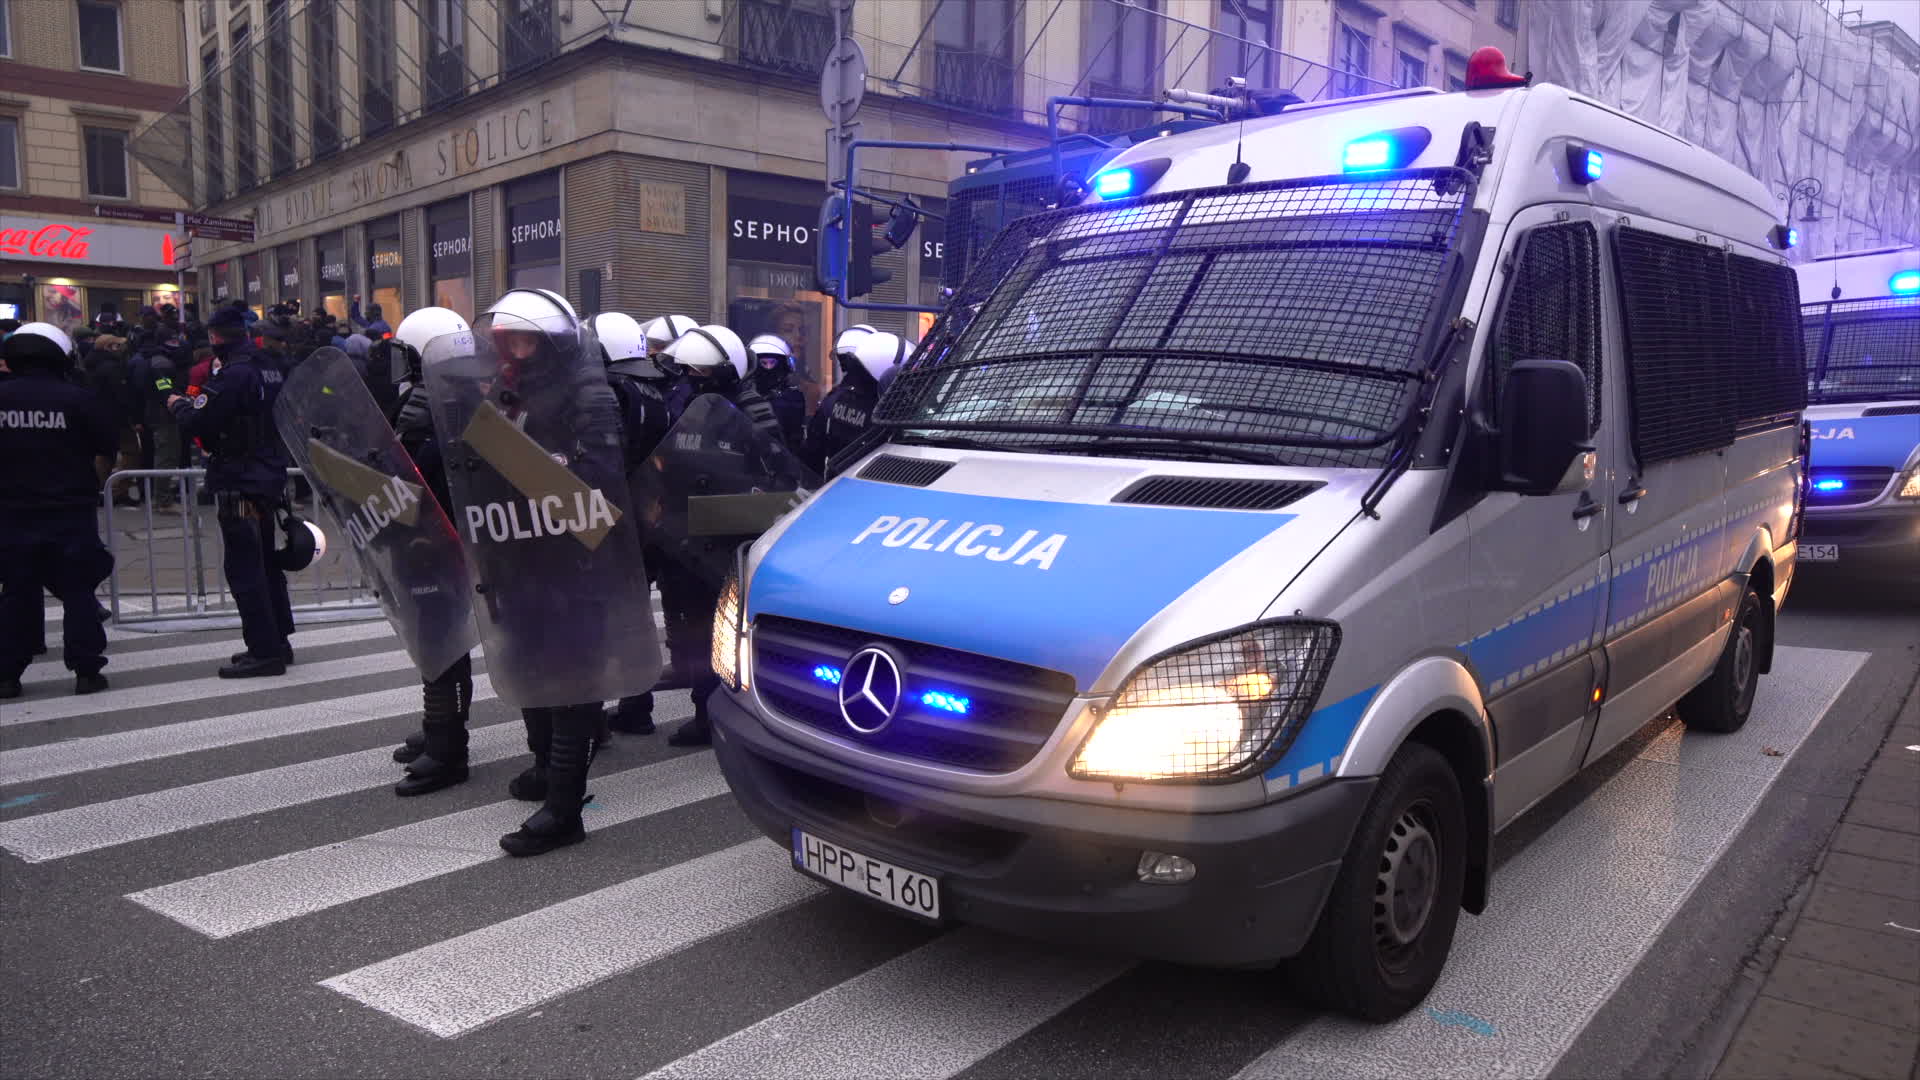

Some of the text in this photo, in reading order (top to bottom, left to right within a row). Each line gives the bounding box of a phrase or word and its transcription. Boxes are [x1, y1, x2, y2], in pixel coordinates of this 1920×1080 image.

[437, 99, 553, 176] STOLICE
[512, 218, 561, 244] SEPHORA
[733, 219, 819, 244] SEPHO
[321, 263, 344, 280] SEPHOR
[344, 475, 419, 550] OLICJA
[465, 488, 616, 544] POLICJA
[851, 515, 1067, 570] POLICJA
[1646, 544, 1698, 603] POLICJA
[805, 836, 934, 913] HPP E160
